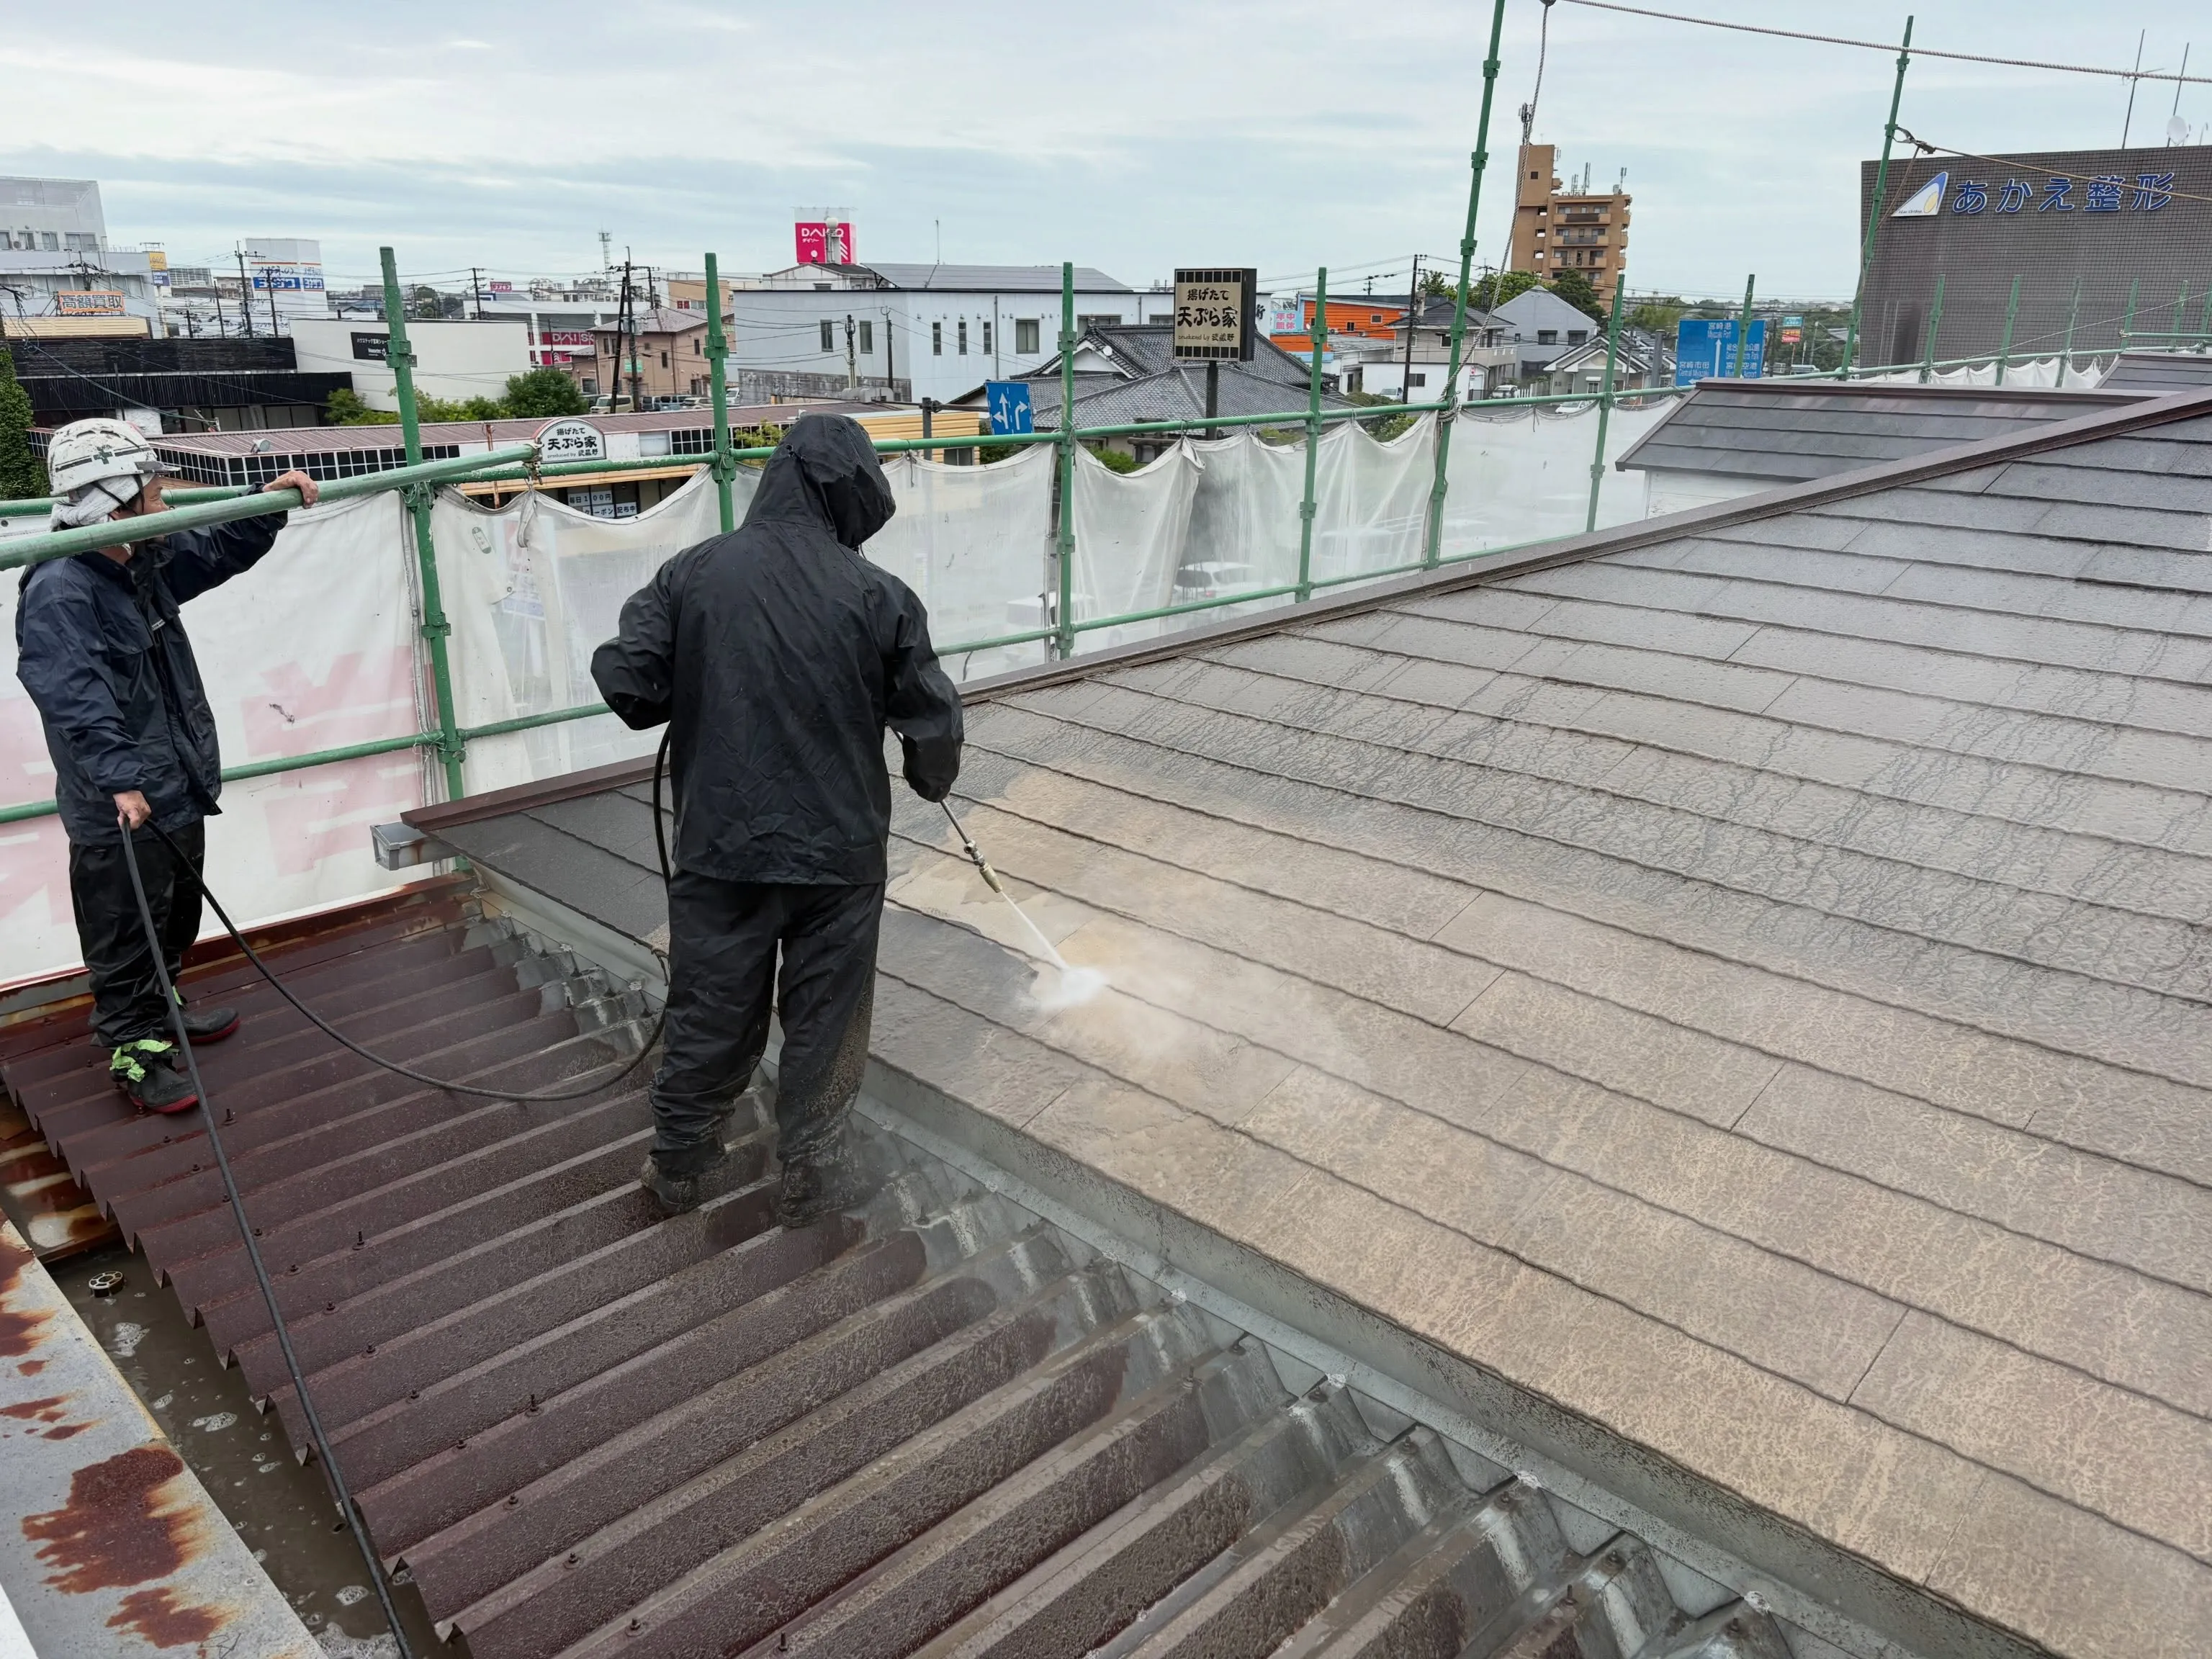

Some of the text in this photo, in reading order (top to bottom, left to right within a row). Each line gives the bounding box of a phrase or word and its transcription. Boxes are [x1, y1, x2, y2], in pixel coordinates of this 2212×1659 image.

[1952, 172, 2175, 213] あかえ整形
[1187, 287, 1230, 301] 揚げたて
[62, 295, 123, 309] 高額買取
[1177, 306, 1238, 328] 天ぷら家
[1211, 333, 1235, 342] 武蔵野
[557, 427, 585, 436] 揚げたて
[547, 436, 597, 451] 天ぷら家
